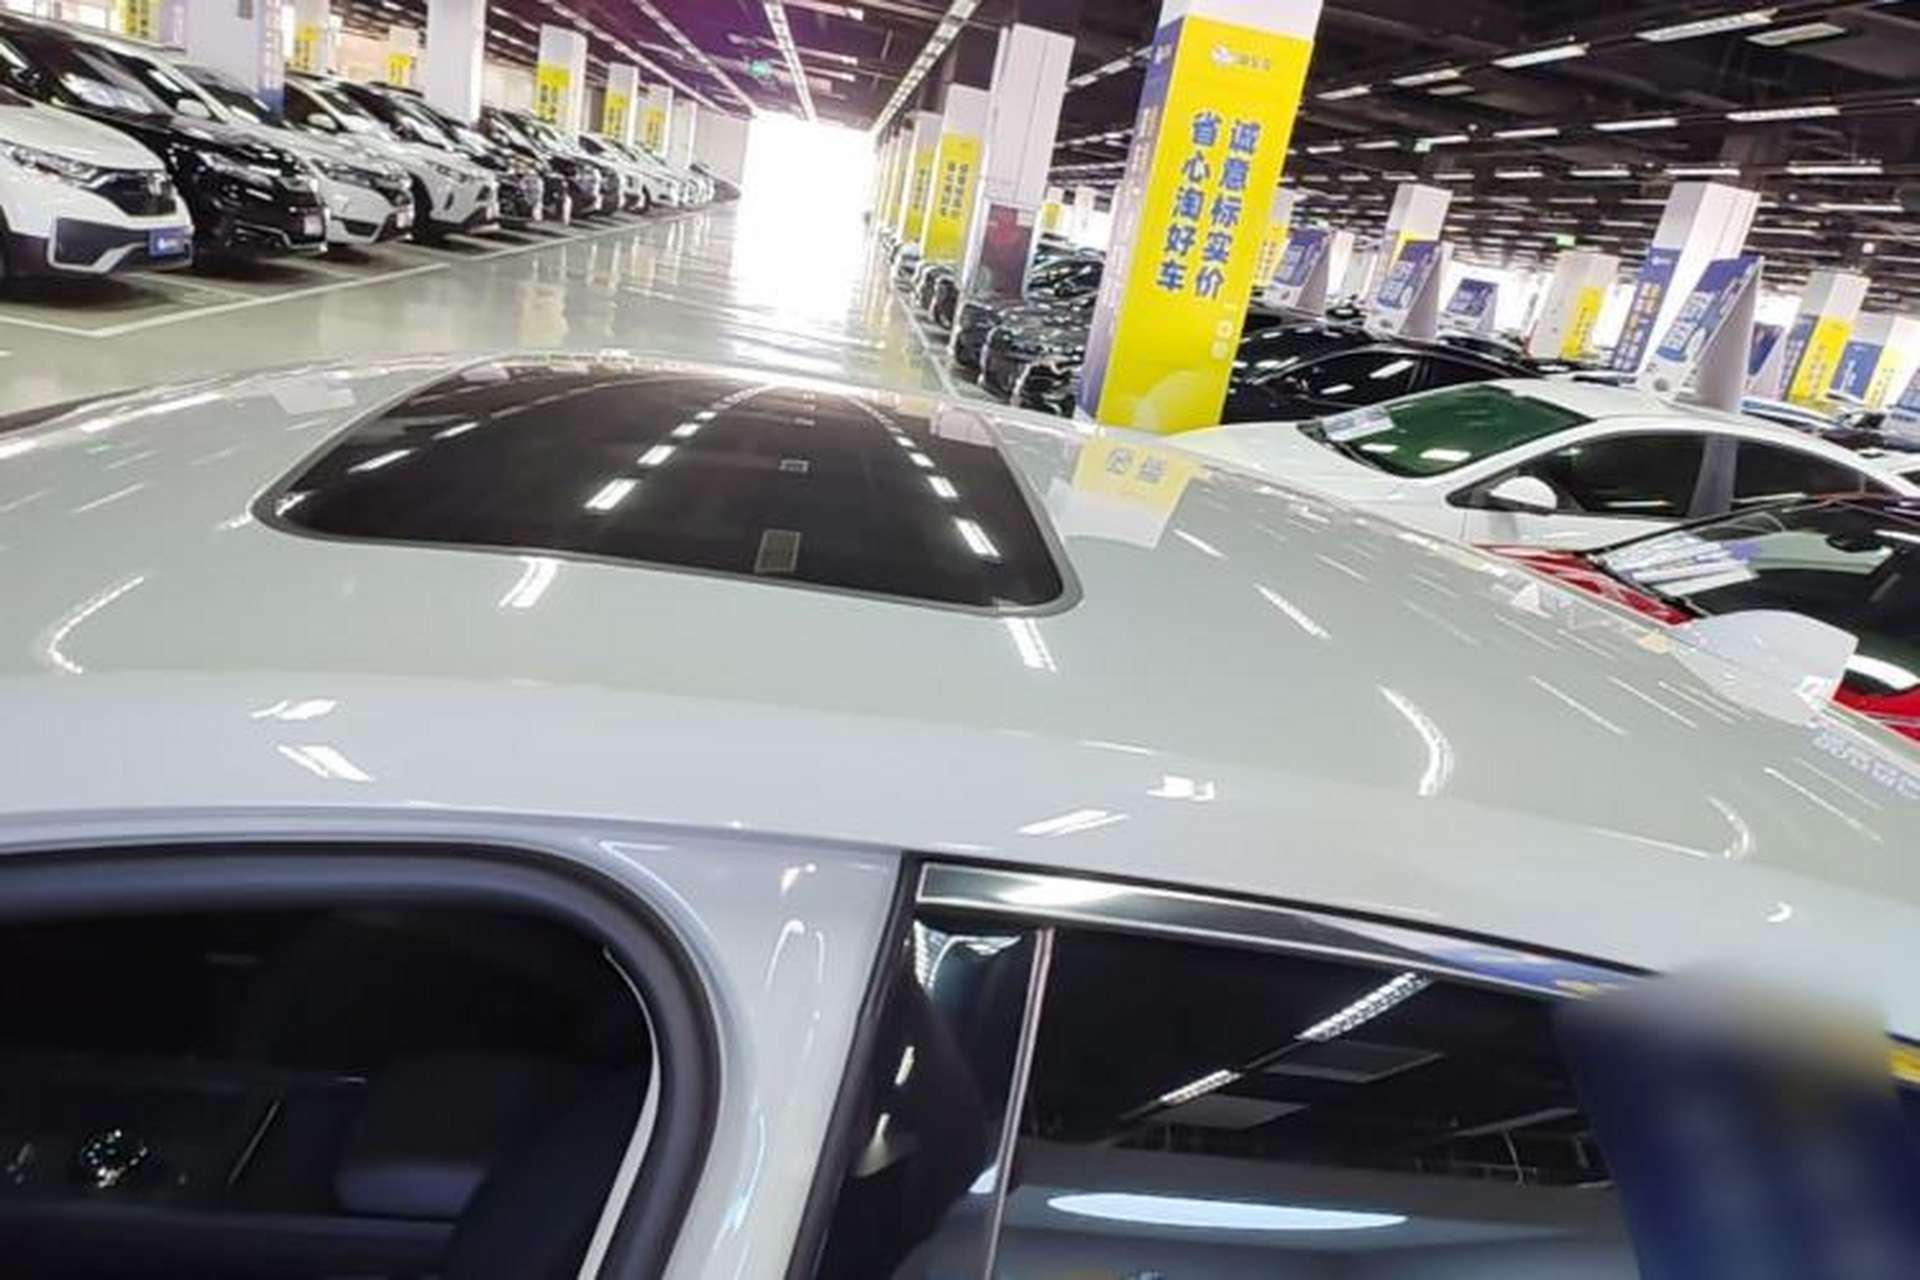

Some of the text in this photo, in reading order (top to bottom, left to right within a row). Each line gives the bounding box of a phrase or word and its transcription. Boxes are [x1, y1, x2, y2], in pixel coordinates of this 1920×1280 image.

[1155, 111, 1222, 292] 省心淘好车
[1194, 119, 1261, 300] 诚意标实价
